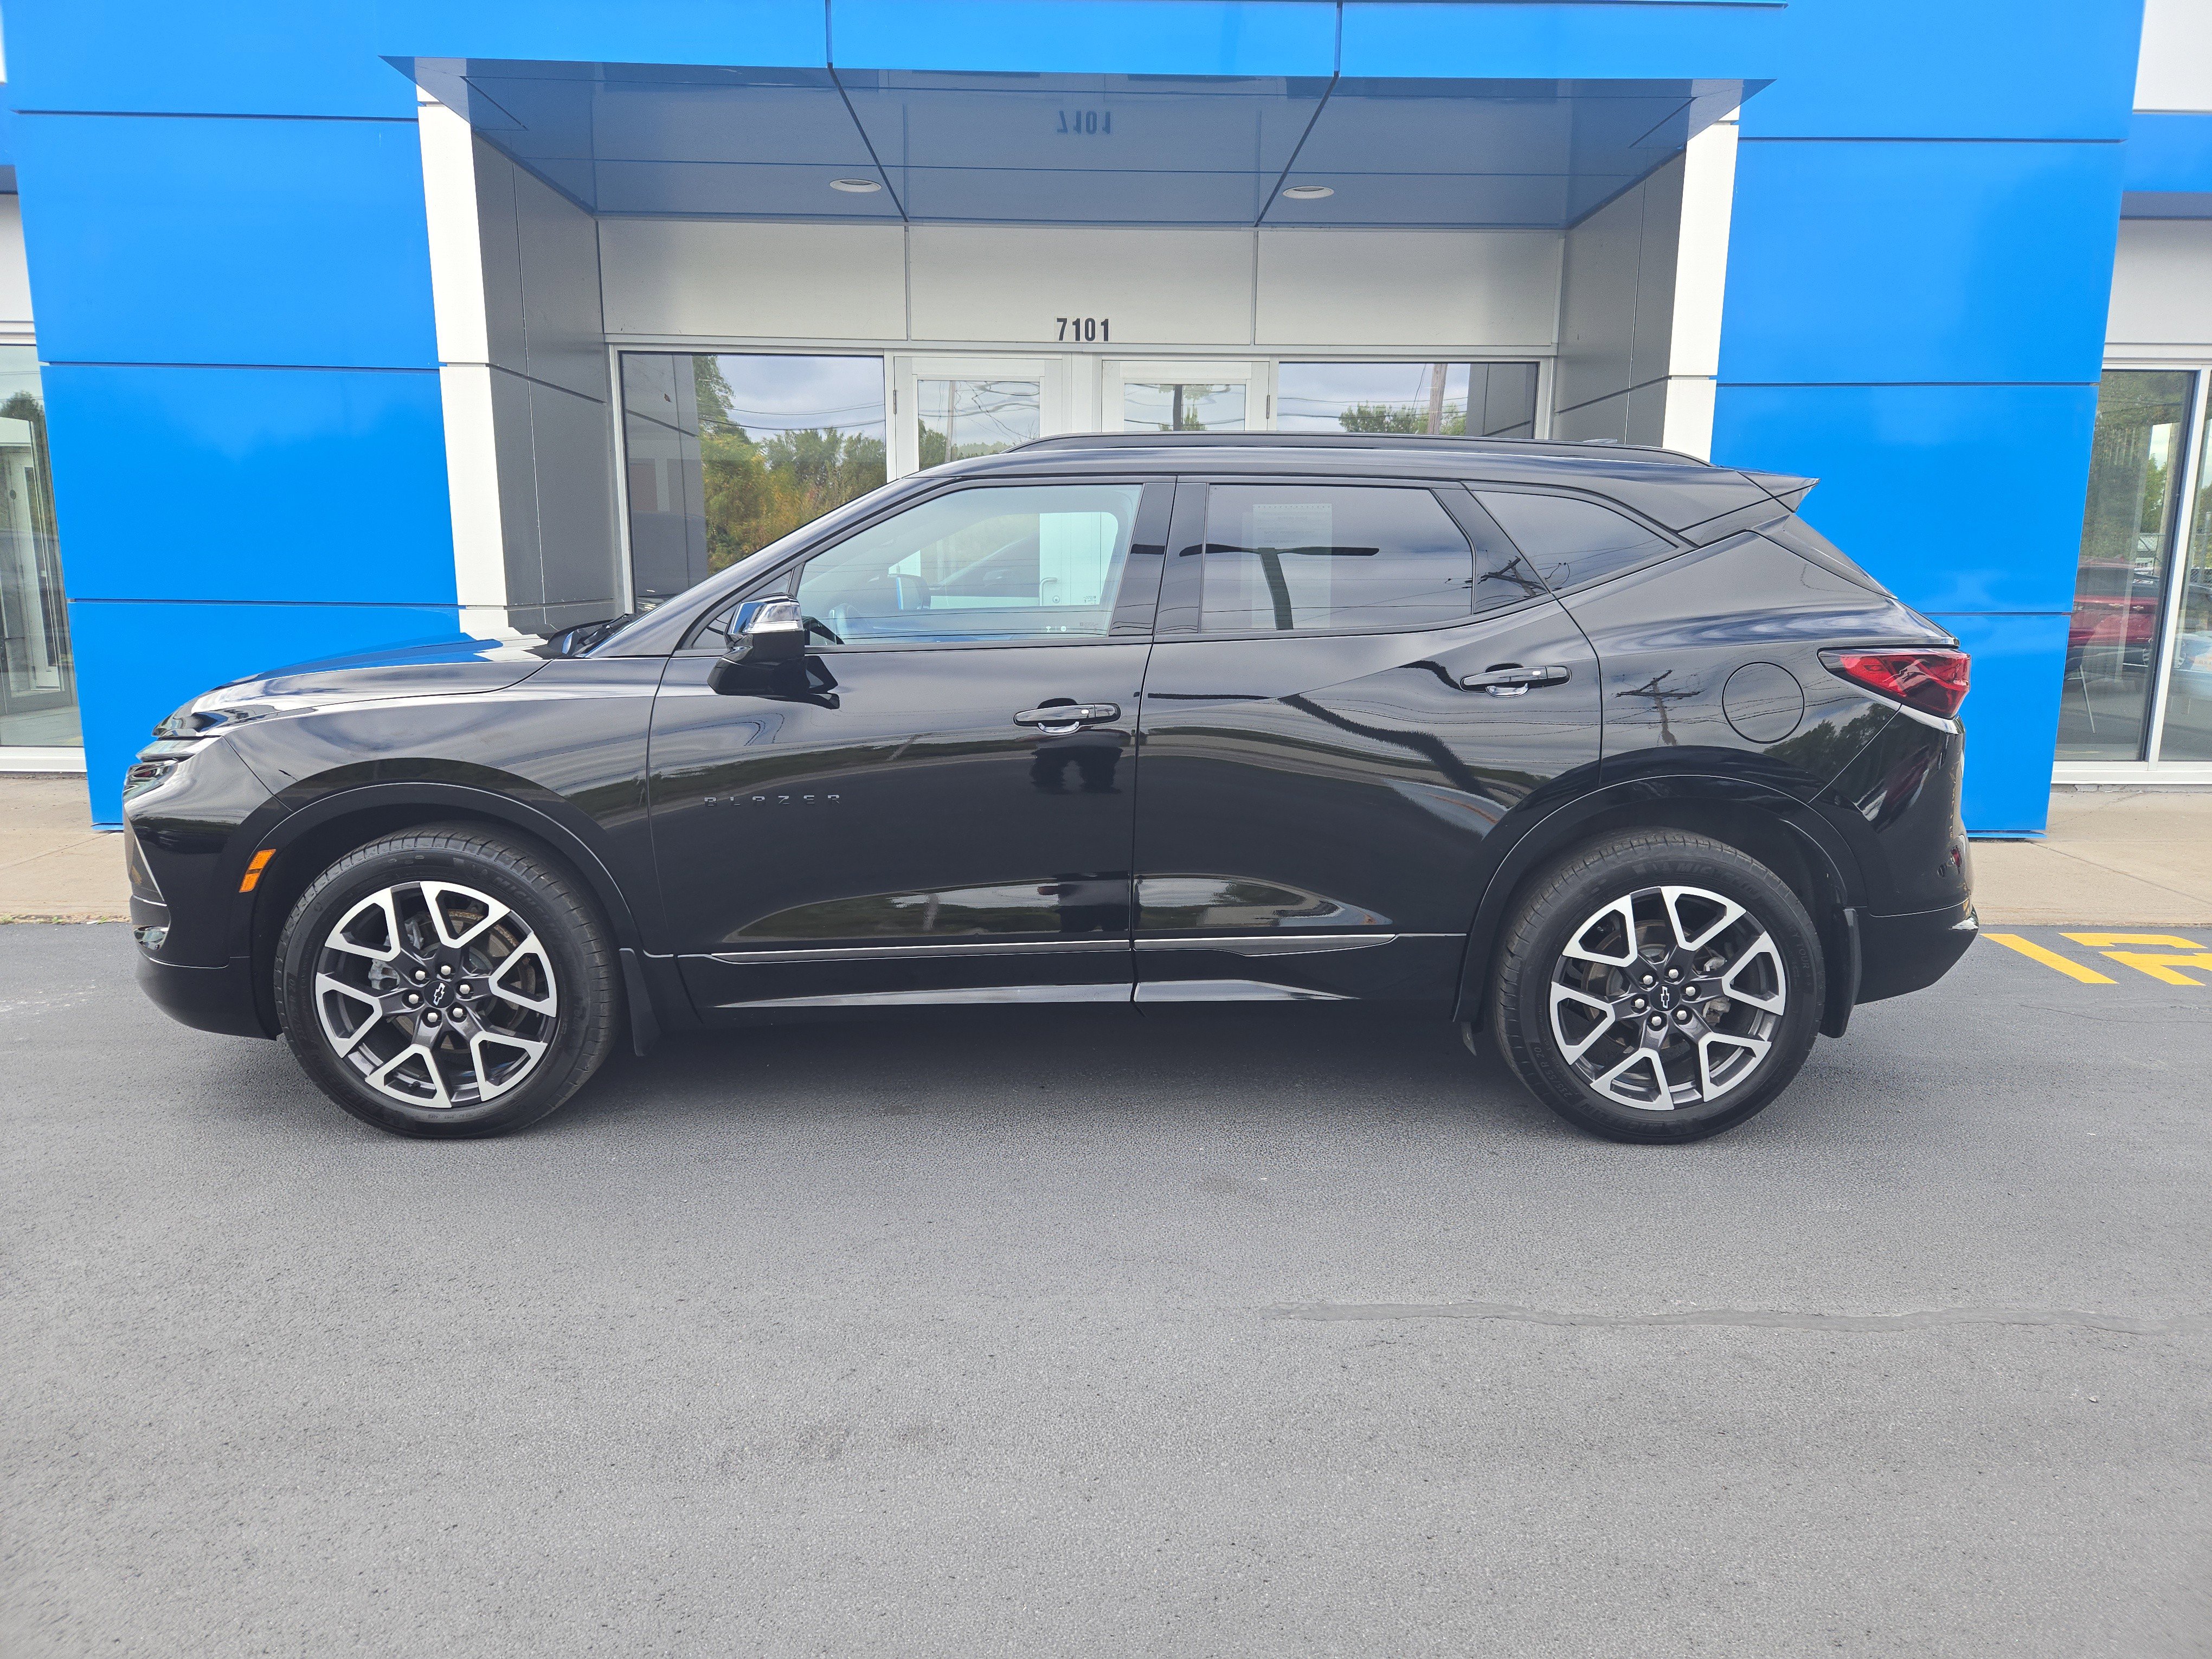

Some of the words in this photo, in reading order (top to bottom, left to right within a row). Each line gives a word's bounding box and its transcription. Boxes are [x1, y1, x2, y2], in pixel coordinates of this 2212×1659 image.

[1057, 318, 1109, 342] 7101
[704, 794, 841, 807] BLAZER
[1533, 1045, 1545, 1060] 20
[1539, 1059, 1549, 1069] R
[1544, 1068, 1573, 1099] 235/55
